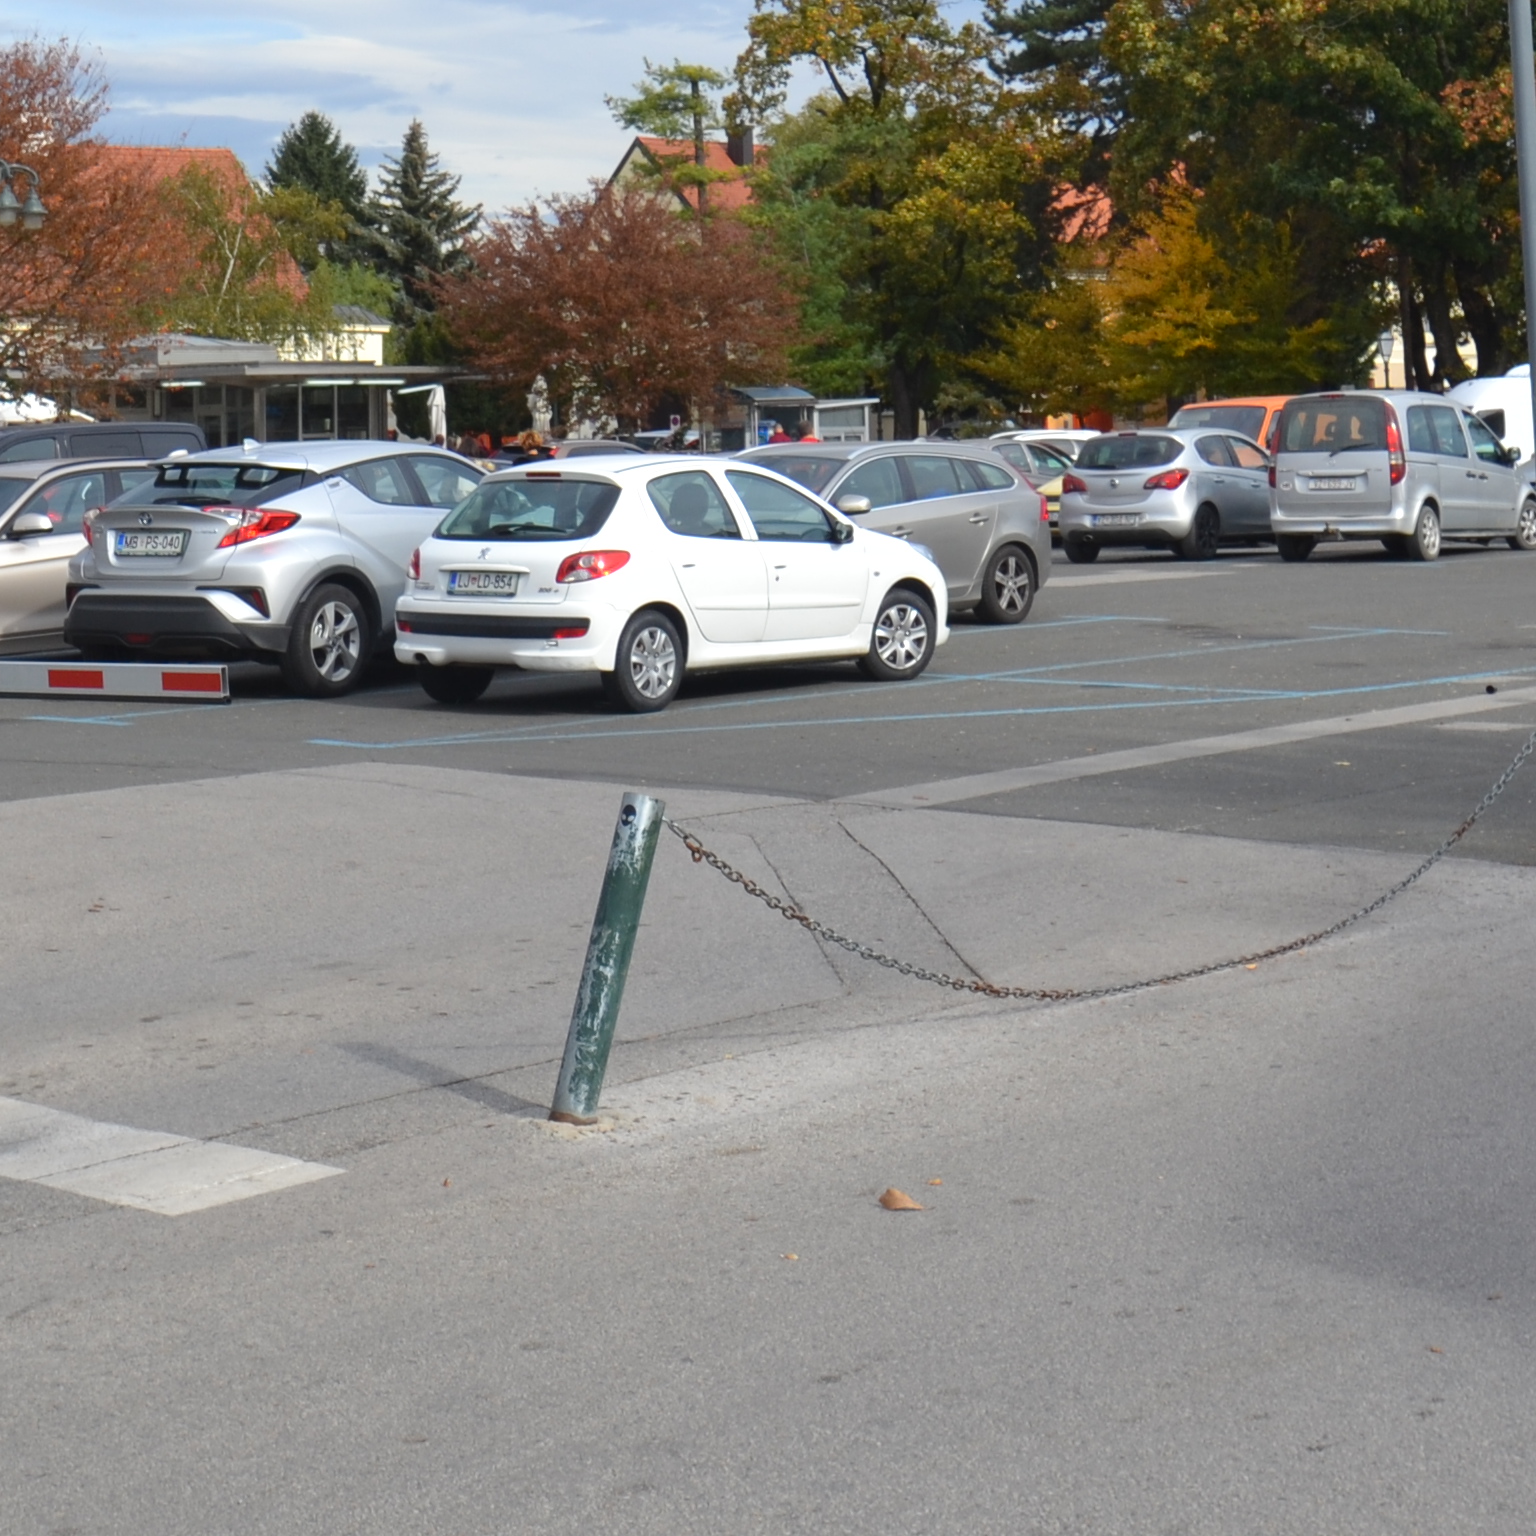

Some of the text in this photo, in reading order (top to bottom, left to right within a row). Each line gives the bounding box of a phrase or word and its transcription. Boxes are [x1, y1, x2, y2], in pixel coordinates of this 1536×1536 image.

[145, 536, 180, 549] PS-040
[458, 574, 512, 590] LJ LD-854
